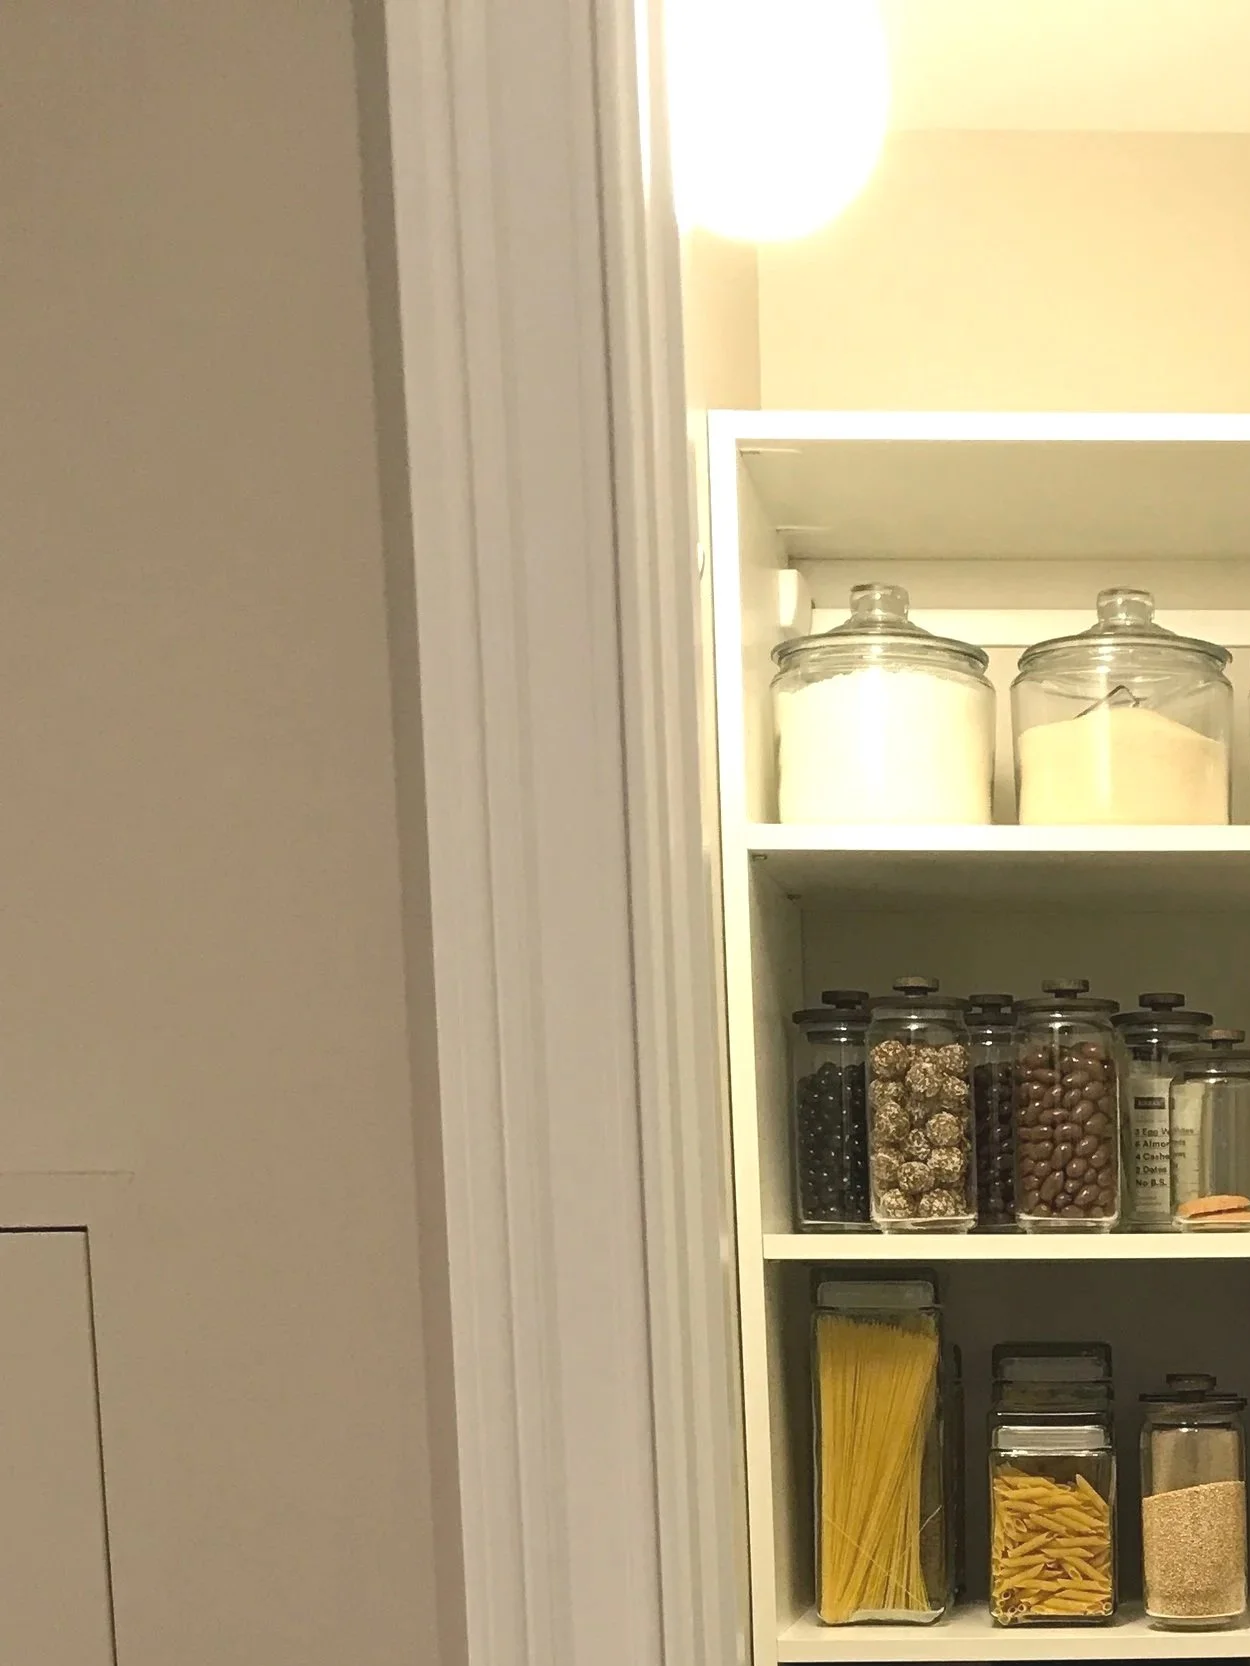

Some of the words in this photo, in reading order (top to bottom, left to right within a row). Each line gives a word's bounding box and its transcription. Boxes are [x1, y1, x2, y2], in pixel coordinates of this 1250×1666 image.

[1142, 1127, 1158, 1137] Egg
[1135, 1178, 1148, 1187] No
[1150, 1178, 1167, 1187] B.S.
